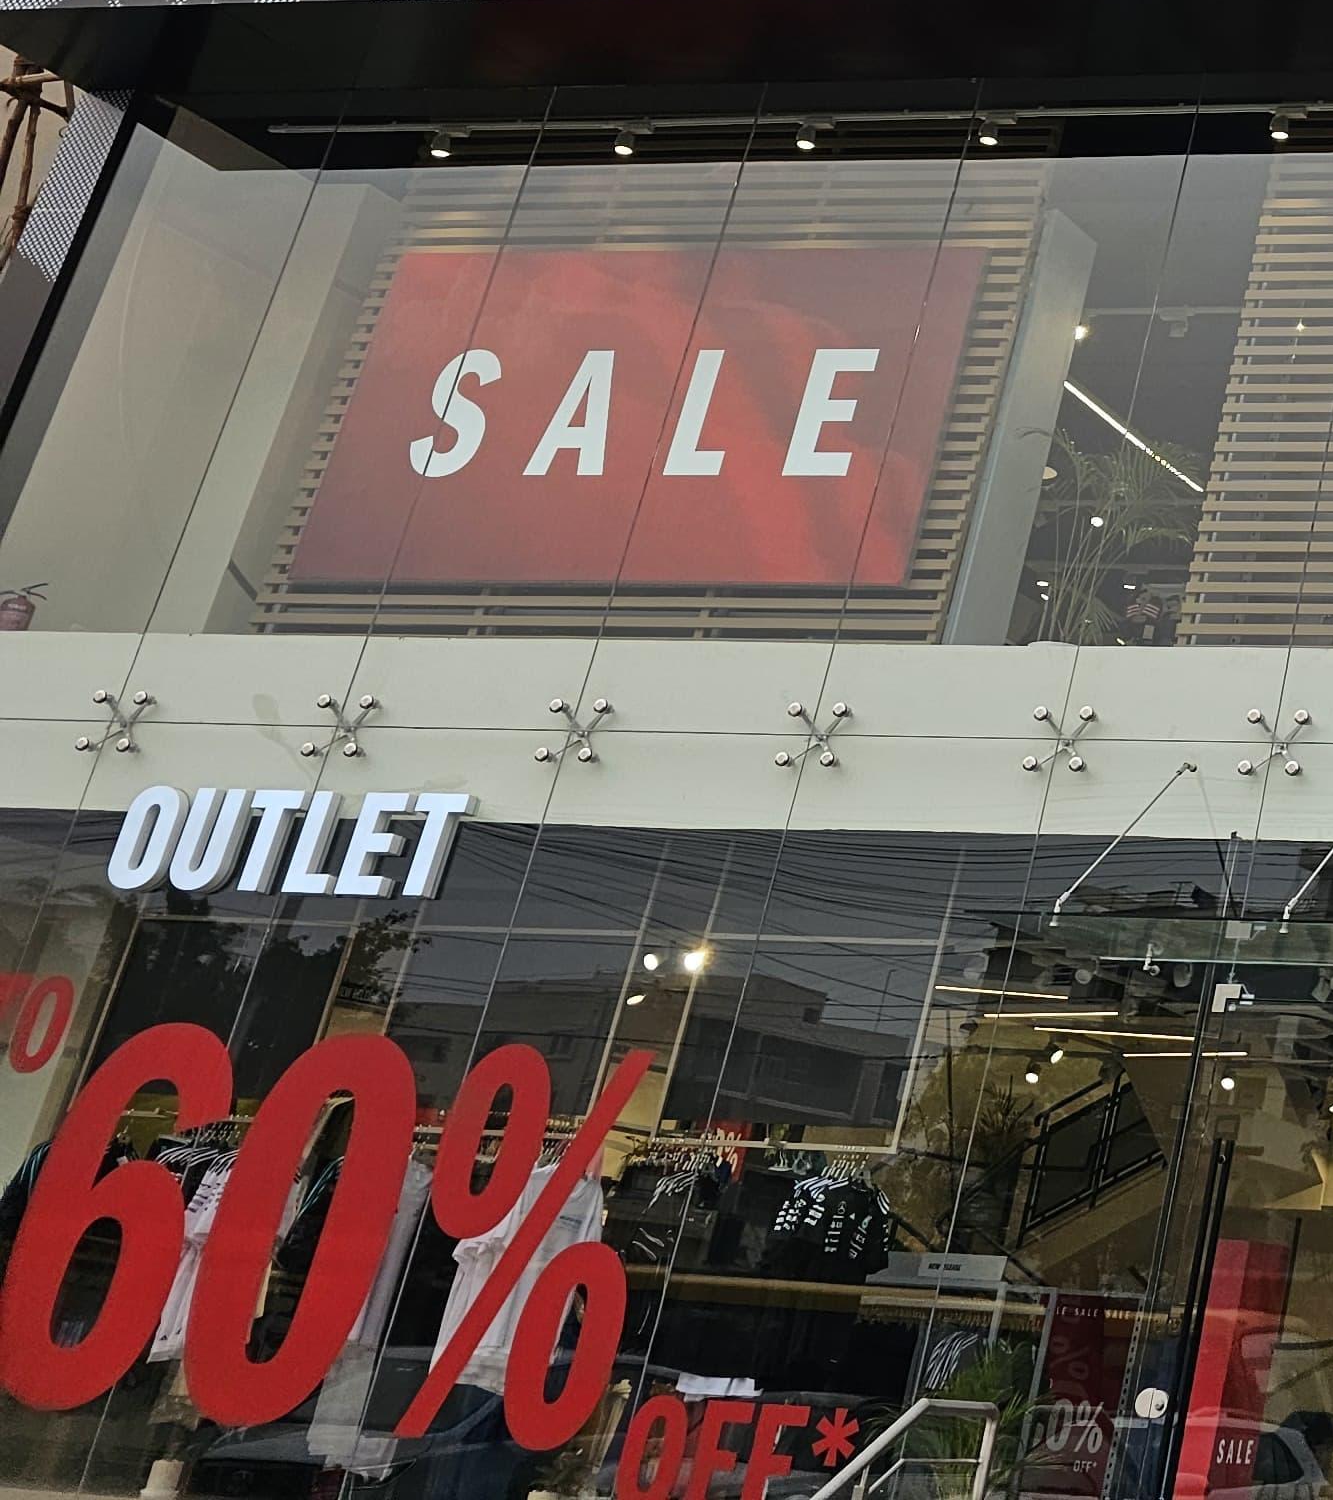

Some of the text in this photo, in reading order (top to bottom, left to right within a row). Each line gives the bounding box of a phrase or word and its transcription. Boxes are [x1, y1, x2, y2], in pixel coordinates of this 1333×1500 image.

[409, 348, 881, 478] SALE
[107, 784, 481, 899] OUTLET
[0, 1023, 658, 1452] 60%
[1216, 1438, 1255, 1464] SALE
